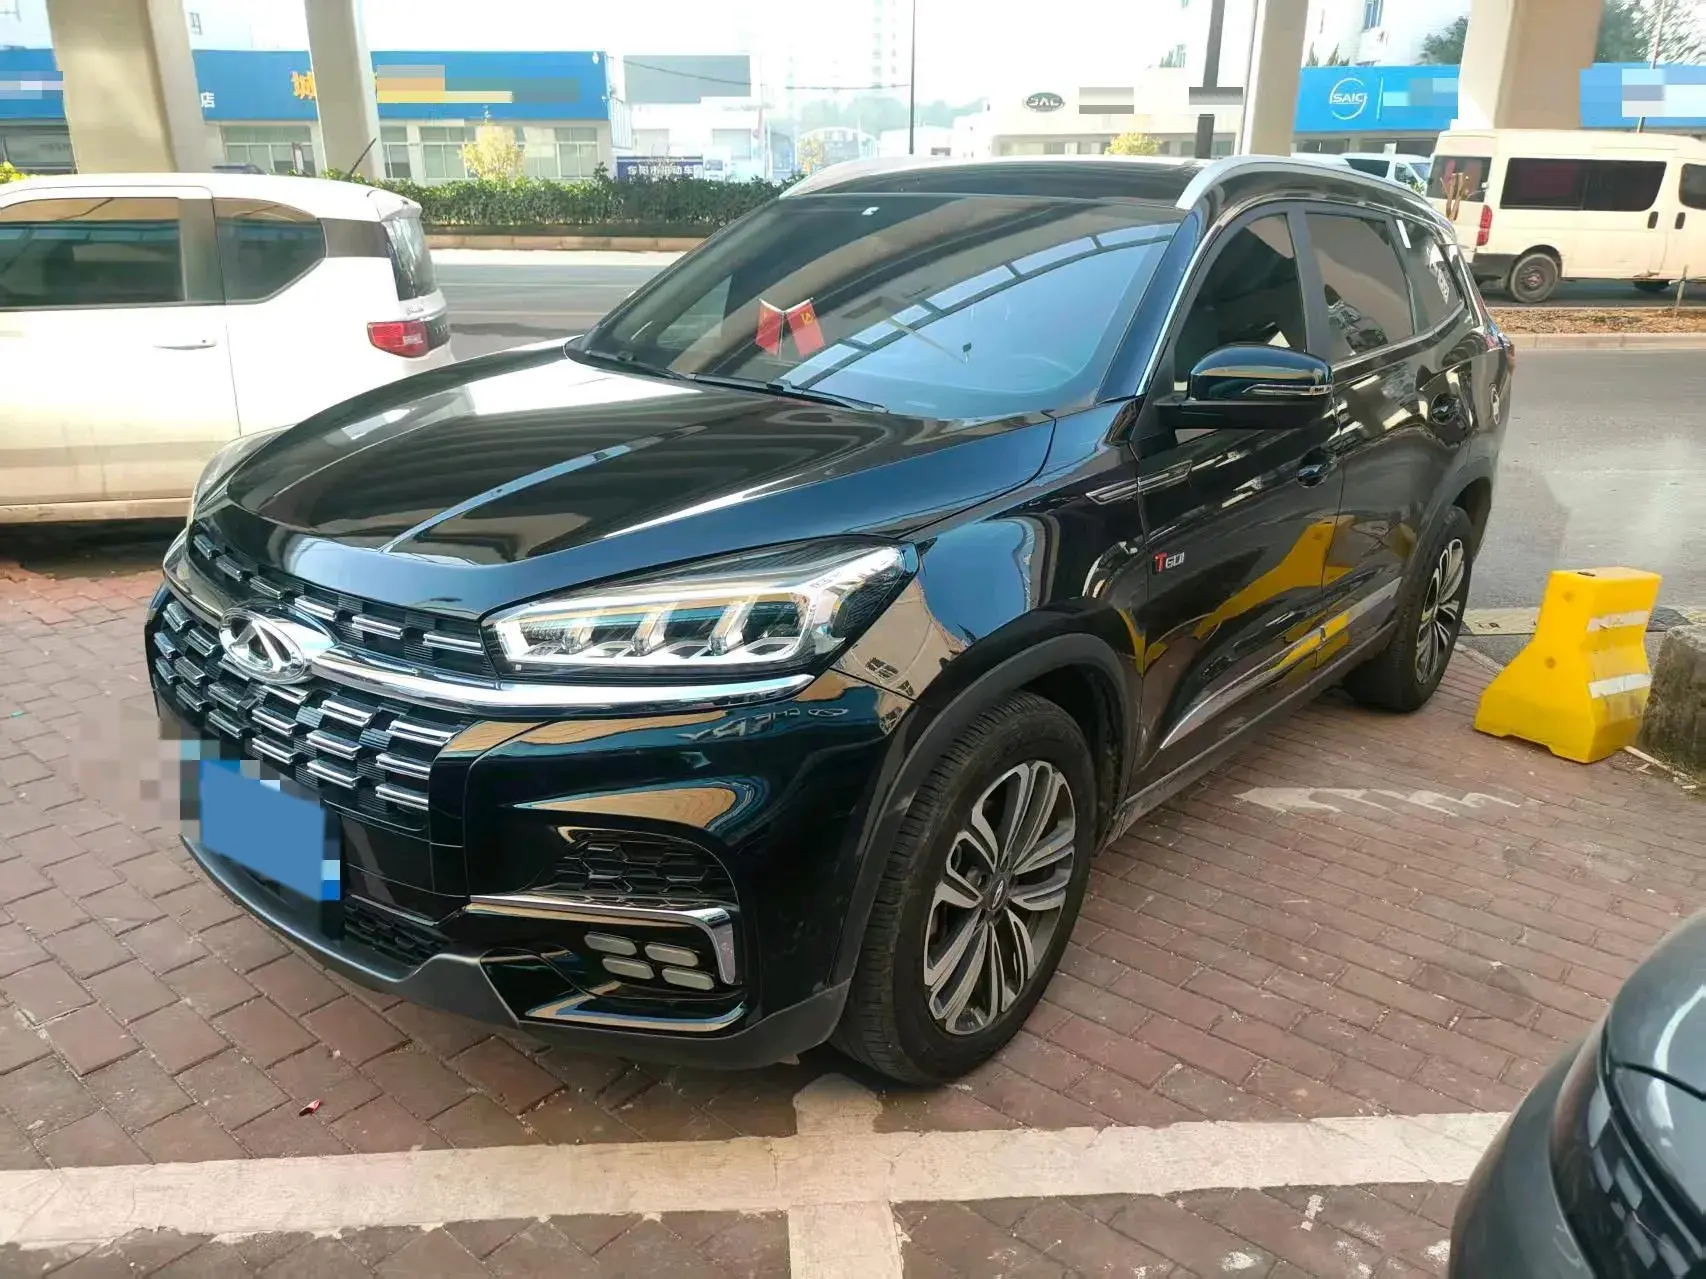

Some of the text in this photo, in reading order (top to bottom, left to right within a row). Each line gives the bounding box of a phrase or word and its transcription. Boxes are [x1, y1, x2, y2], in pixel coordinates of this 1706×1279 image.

[200, 91, 216, 108] 店
[1332, 93, 1367, 104] SAIC
[1153, 552, 1185, 572] TGDI
